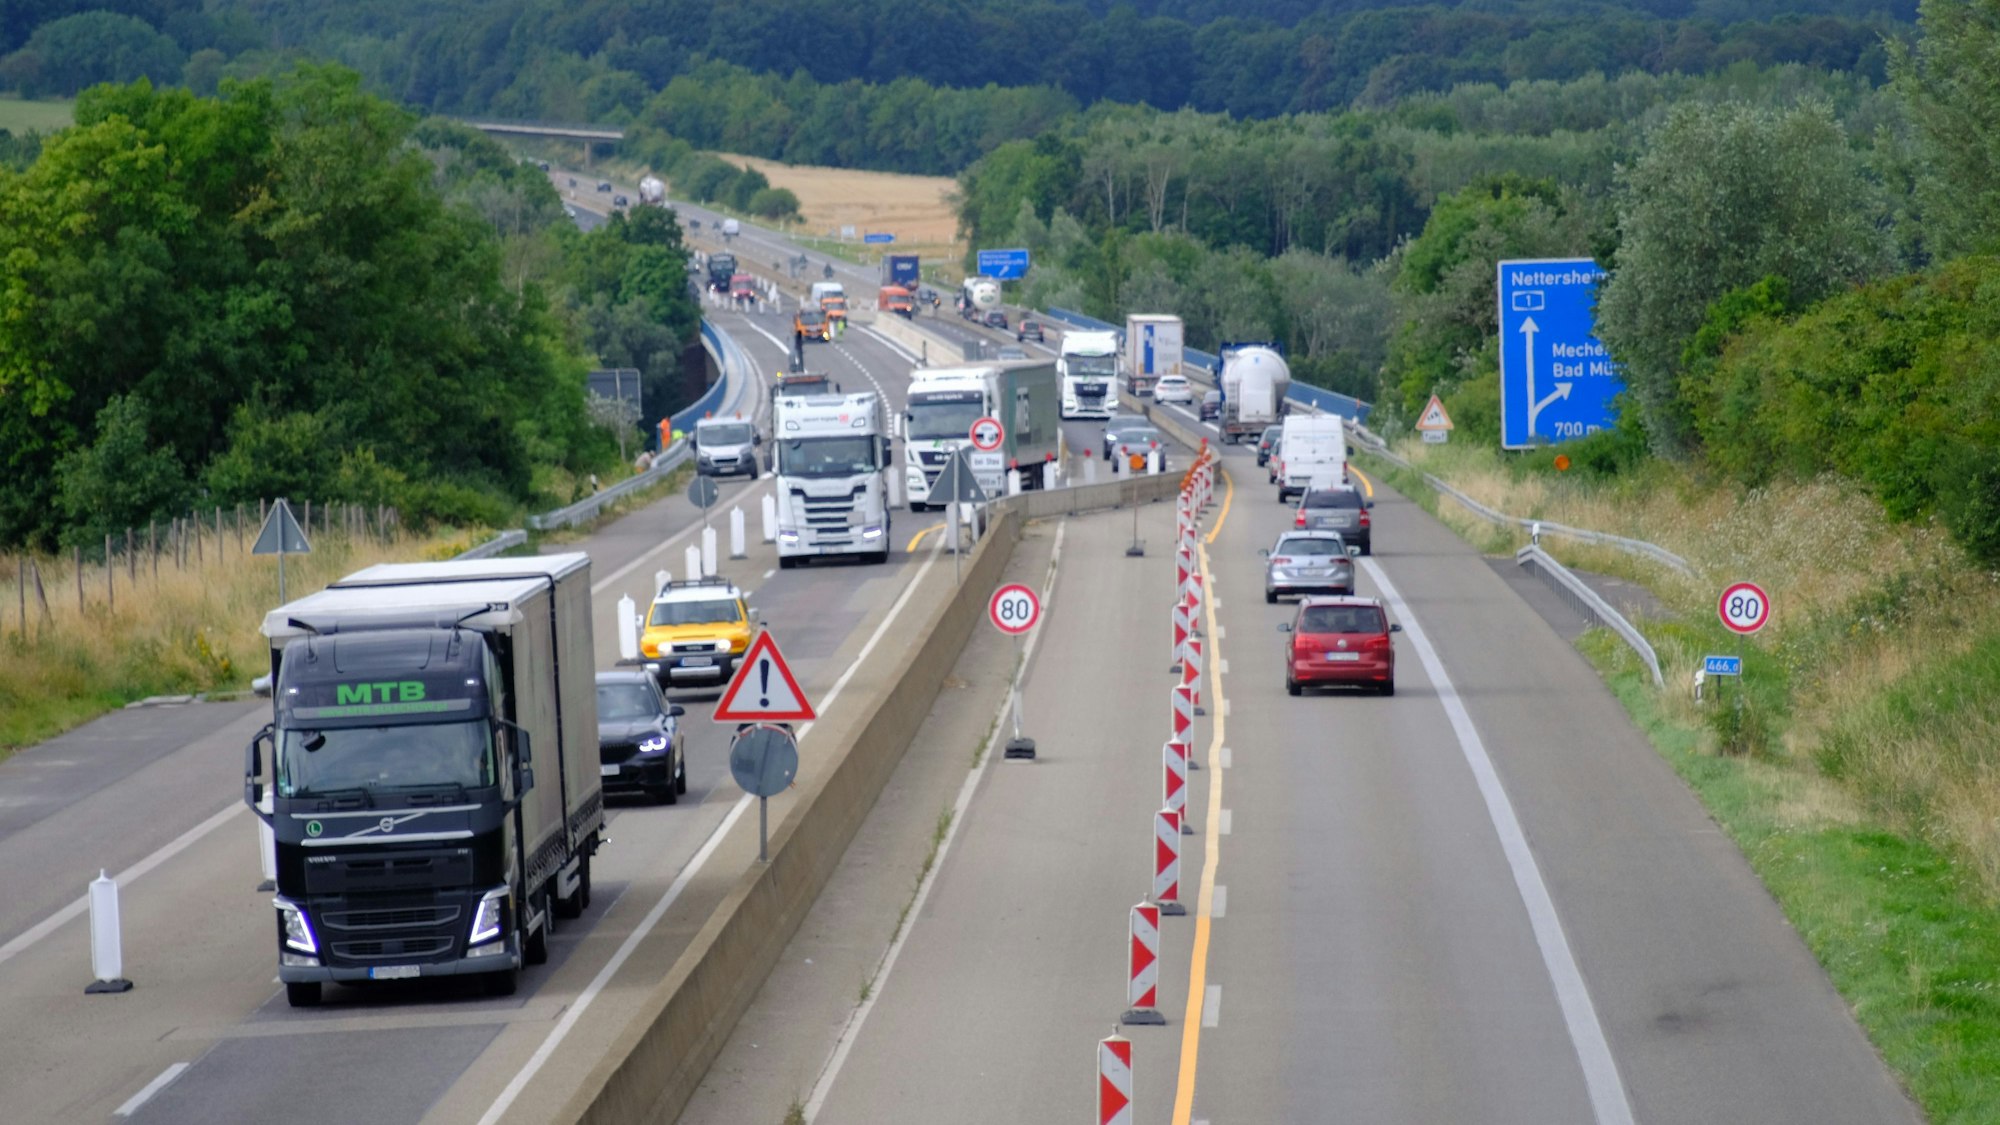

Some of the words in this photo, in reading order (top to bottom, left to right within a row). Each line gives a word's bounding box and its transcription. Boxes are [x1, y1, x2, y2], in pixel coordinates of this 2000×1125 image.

[1525, 294, 1532, 307] 1
[1553, 361, 1583, 378] Bad
[1554, 421, 1583, 437] 700
[1001, 599, 1029, 620] 80
[1730, 596, 1759, 620] 80
[336, 680, 426, 705] MTB
